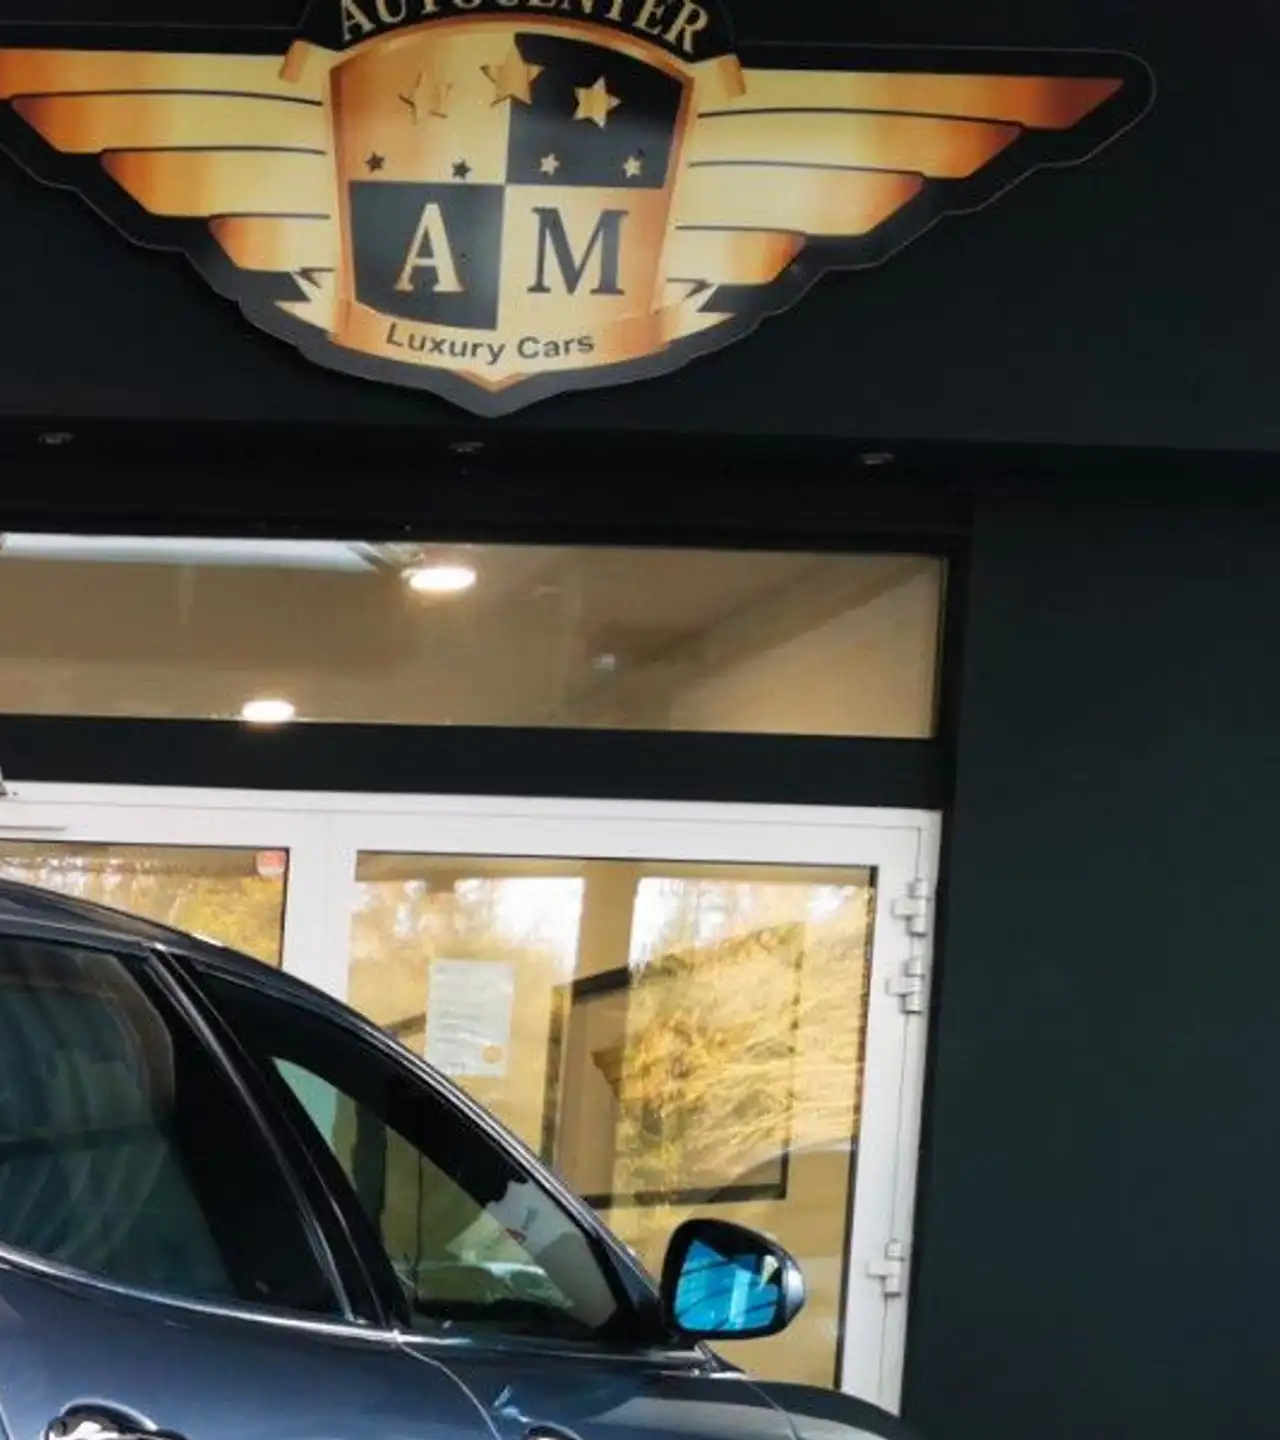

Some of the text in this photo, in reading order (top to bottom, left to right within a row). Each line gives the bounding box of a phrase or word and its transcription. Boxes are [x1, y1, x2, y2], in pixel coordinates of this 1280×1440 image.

[341, 0, 709, 54] AUTER
[392, 201, 630, 295] A M
[385, 322, 596, 366] Luxury Cars
